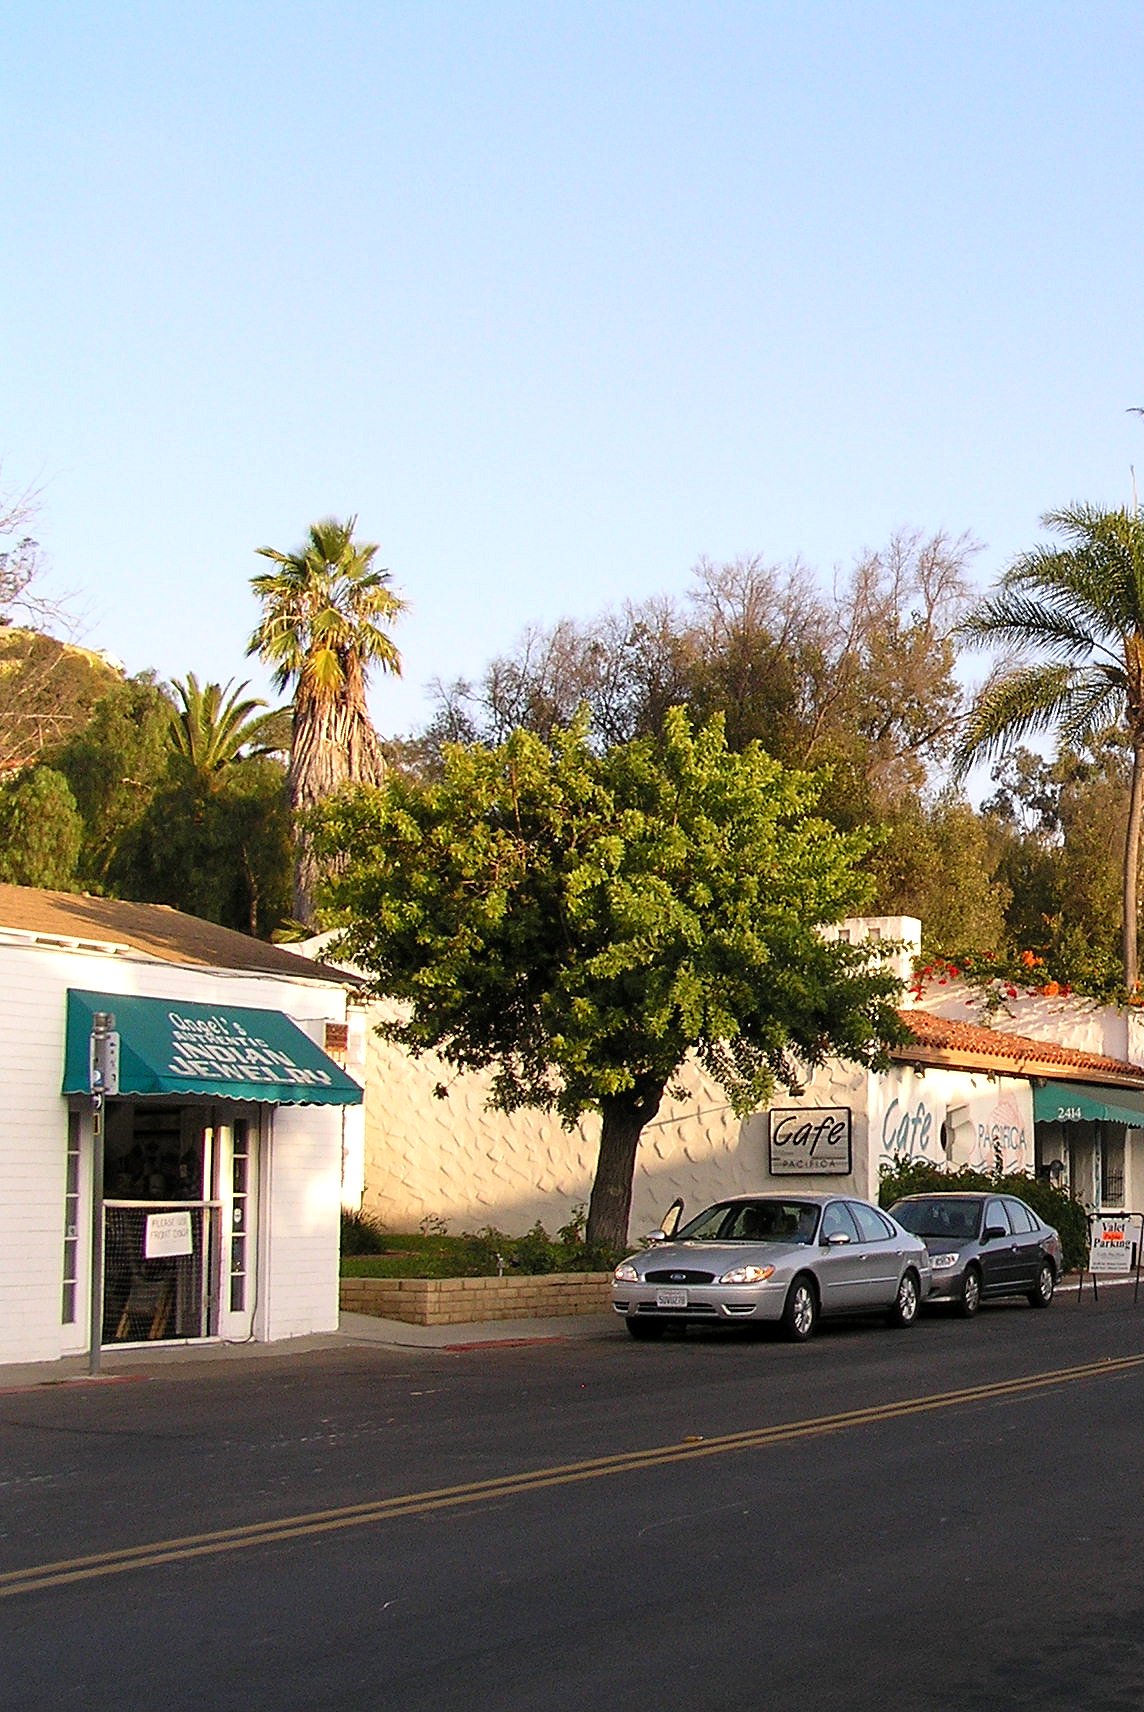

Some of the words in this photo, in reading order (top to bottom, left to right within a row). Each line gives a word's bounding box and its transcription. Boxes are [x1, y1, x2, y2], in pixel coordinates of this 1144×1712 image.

[172, 1030, 269, 1048] AUTHENTIC
[172, 1042, 296, 1067] INDIAN
[168, 1056, 332, 1085] JEWELRY
[1057, 1106, 1082, 1119] 2414
[773, 1115, 846, 1156] Cafe
[882, 1098, 933, 1158] Cafe
[782, 1160, 836, 1169] PACIFICA
[1102, 1222, 1126, 1232] Valet
[1094, 1238, 1131, 1249] Parking
